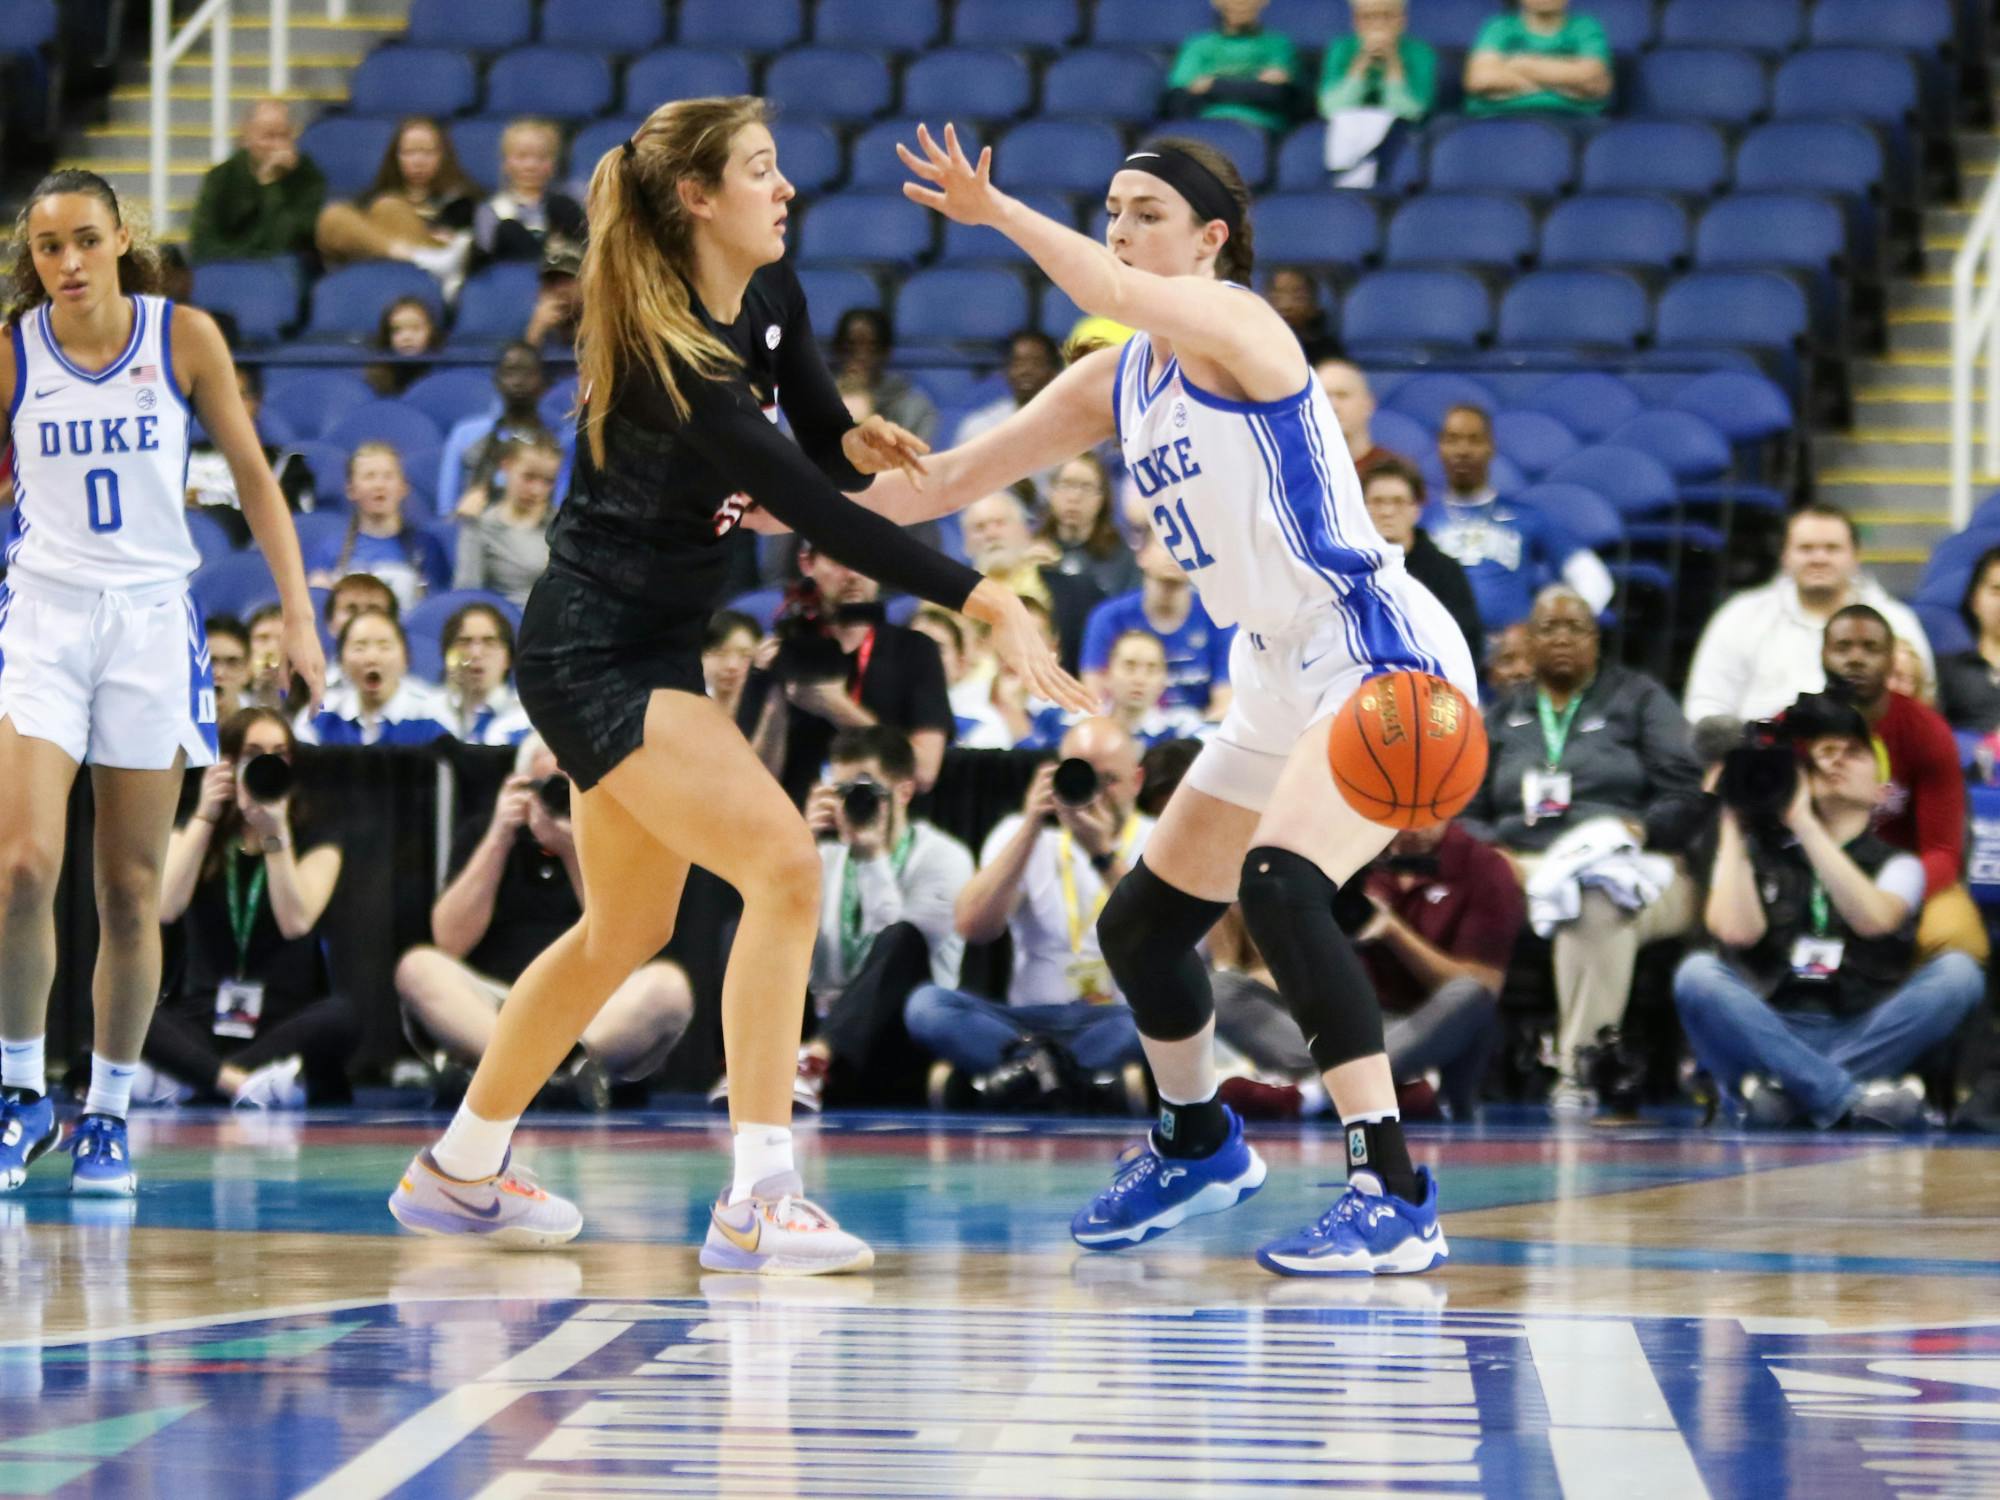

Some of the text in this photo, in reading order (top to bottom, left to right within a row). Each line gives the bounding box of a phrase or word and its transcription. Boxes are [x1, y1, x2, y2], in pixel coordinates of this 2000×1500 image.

[38, 415, 159, 457] DUKE
[1127, 436, 1202, 498] UKE
[84, 468, 123, 535] 0
[1153, 497, 1216, 571] 21
